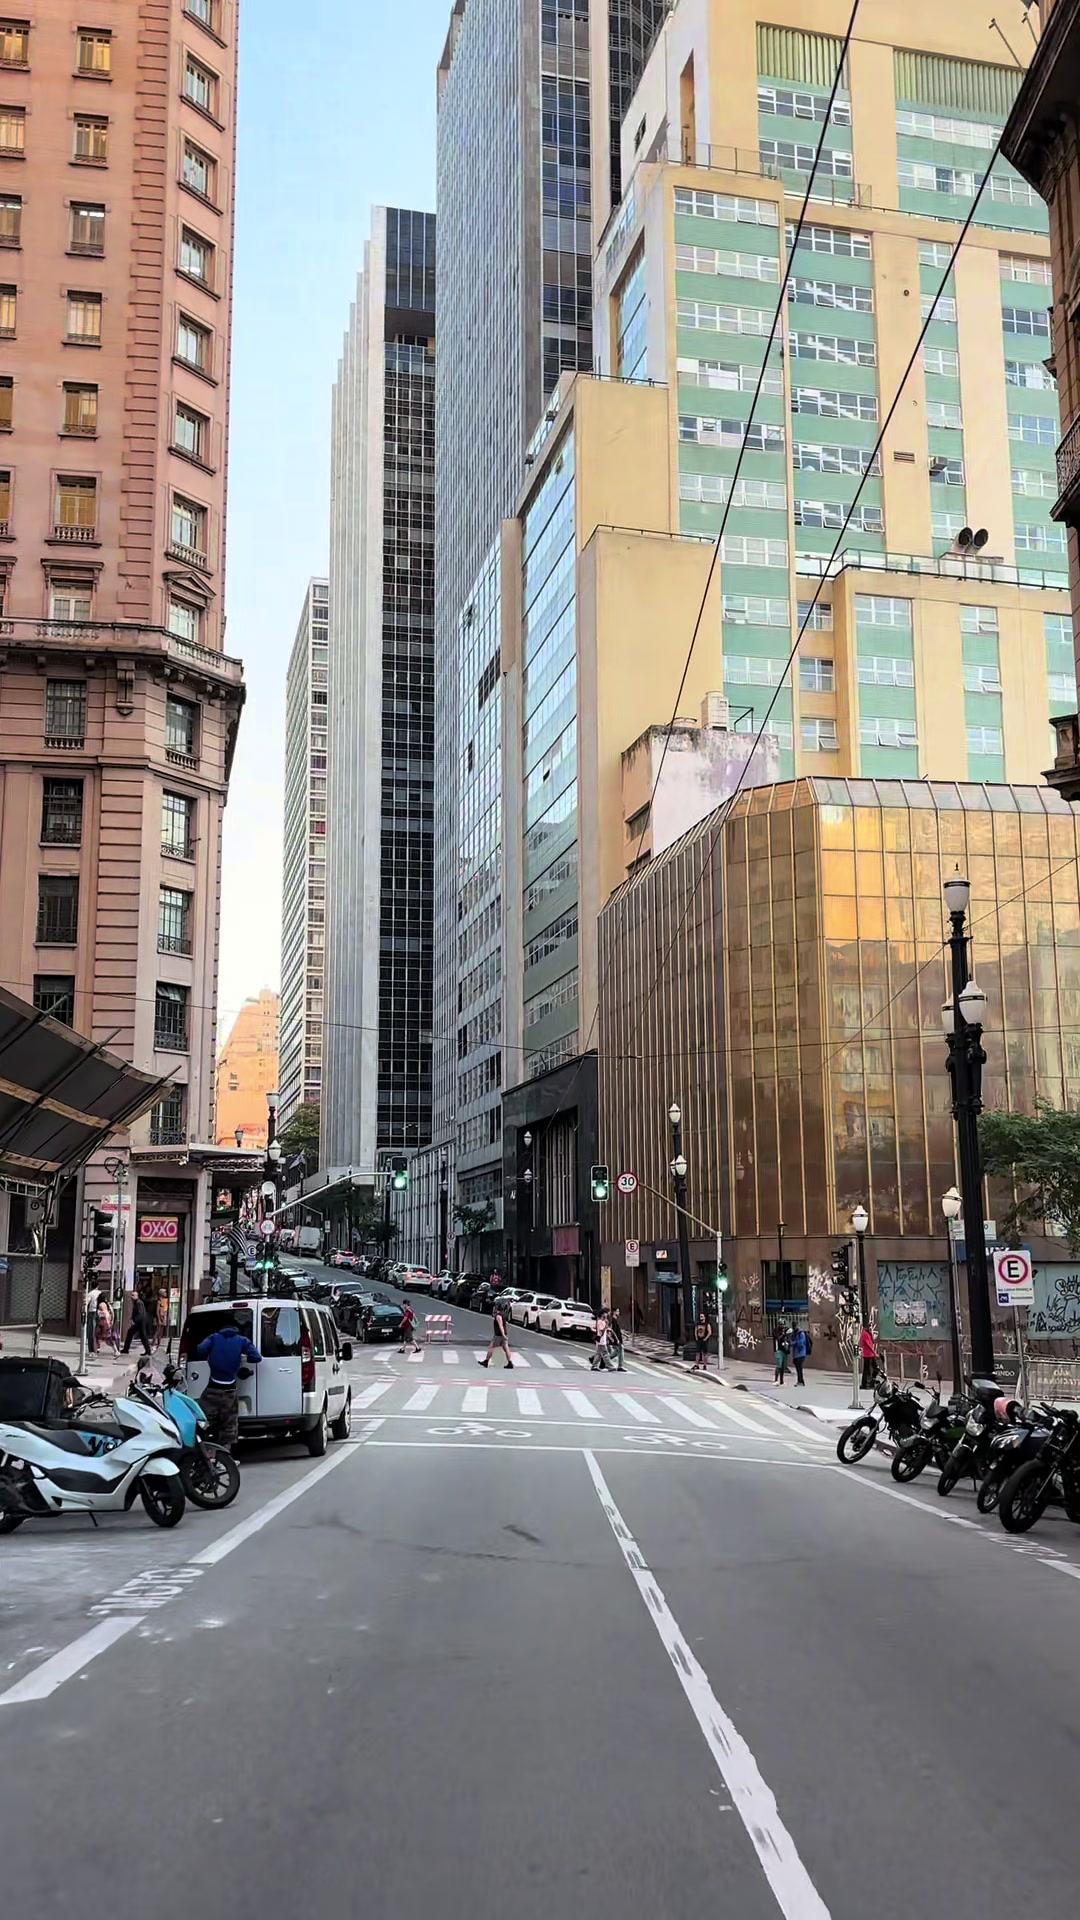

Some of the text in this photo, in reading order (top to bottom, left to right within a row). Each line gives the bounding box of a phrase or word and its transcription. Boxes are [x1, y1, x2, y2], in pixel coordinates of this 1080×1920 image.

[621, 1176, 635, 1186] 30
[140, 1221, 177, 1237] OXXO
[1007, 1260, 1020, 1278] E
